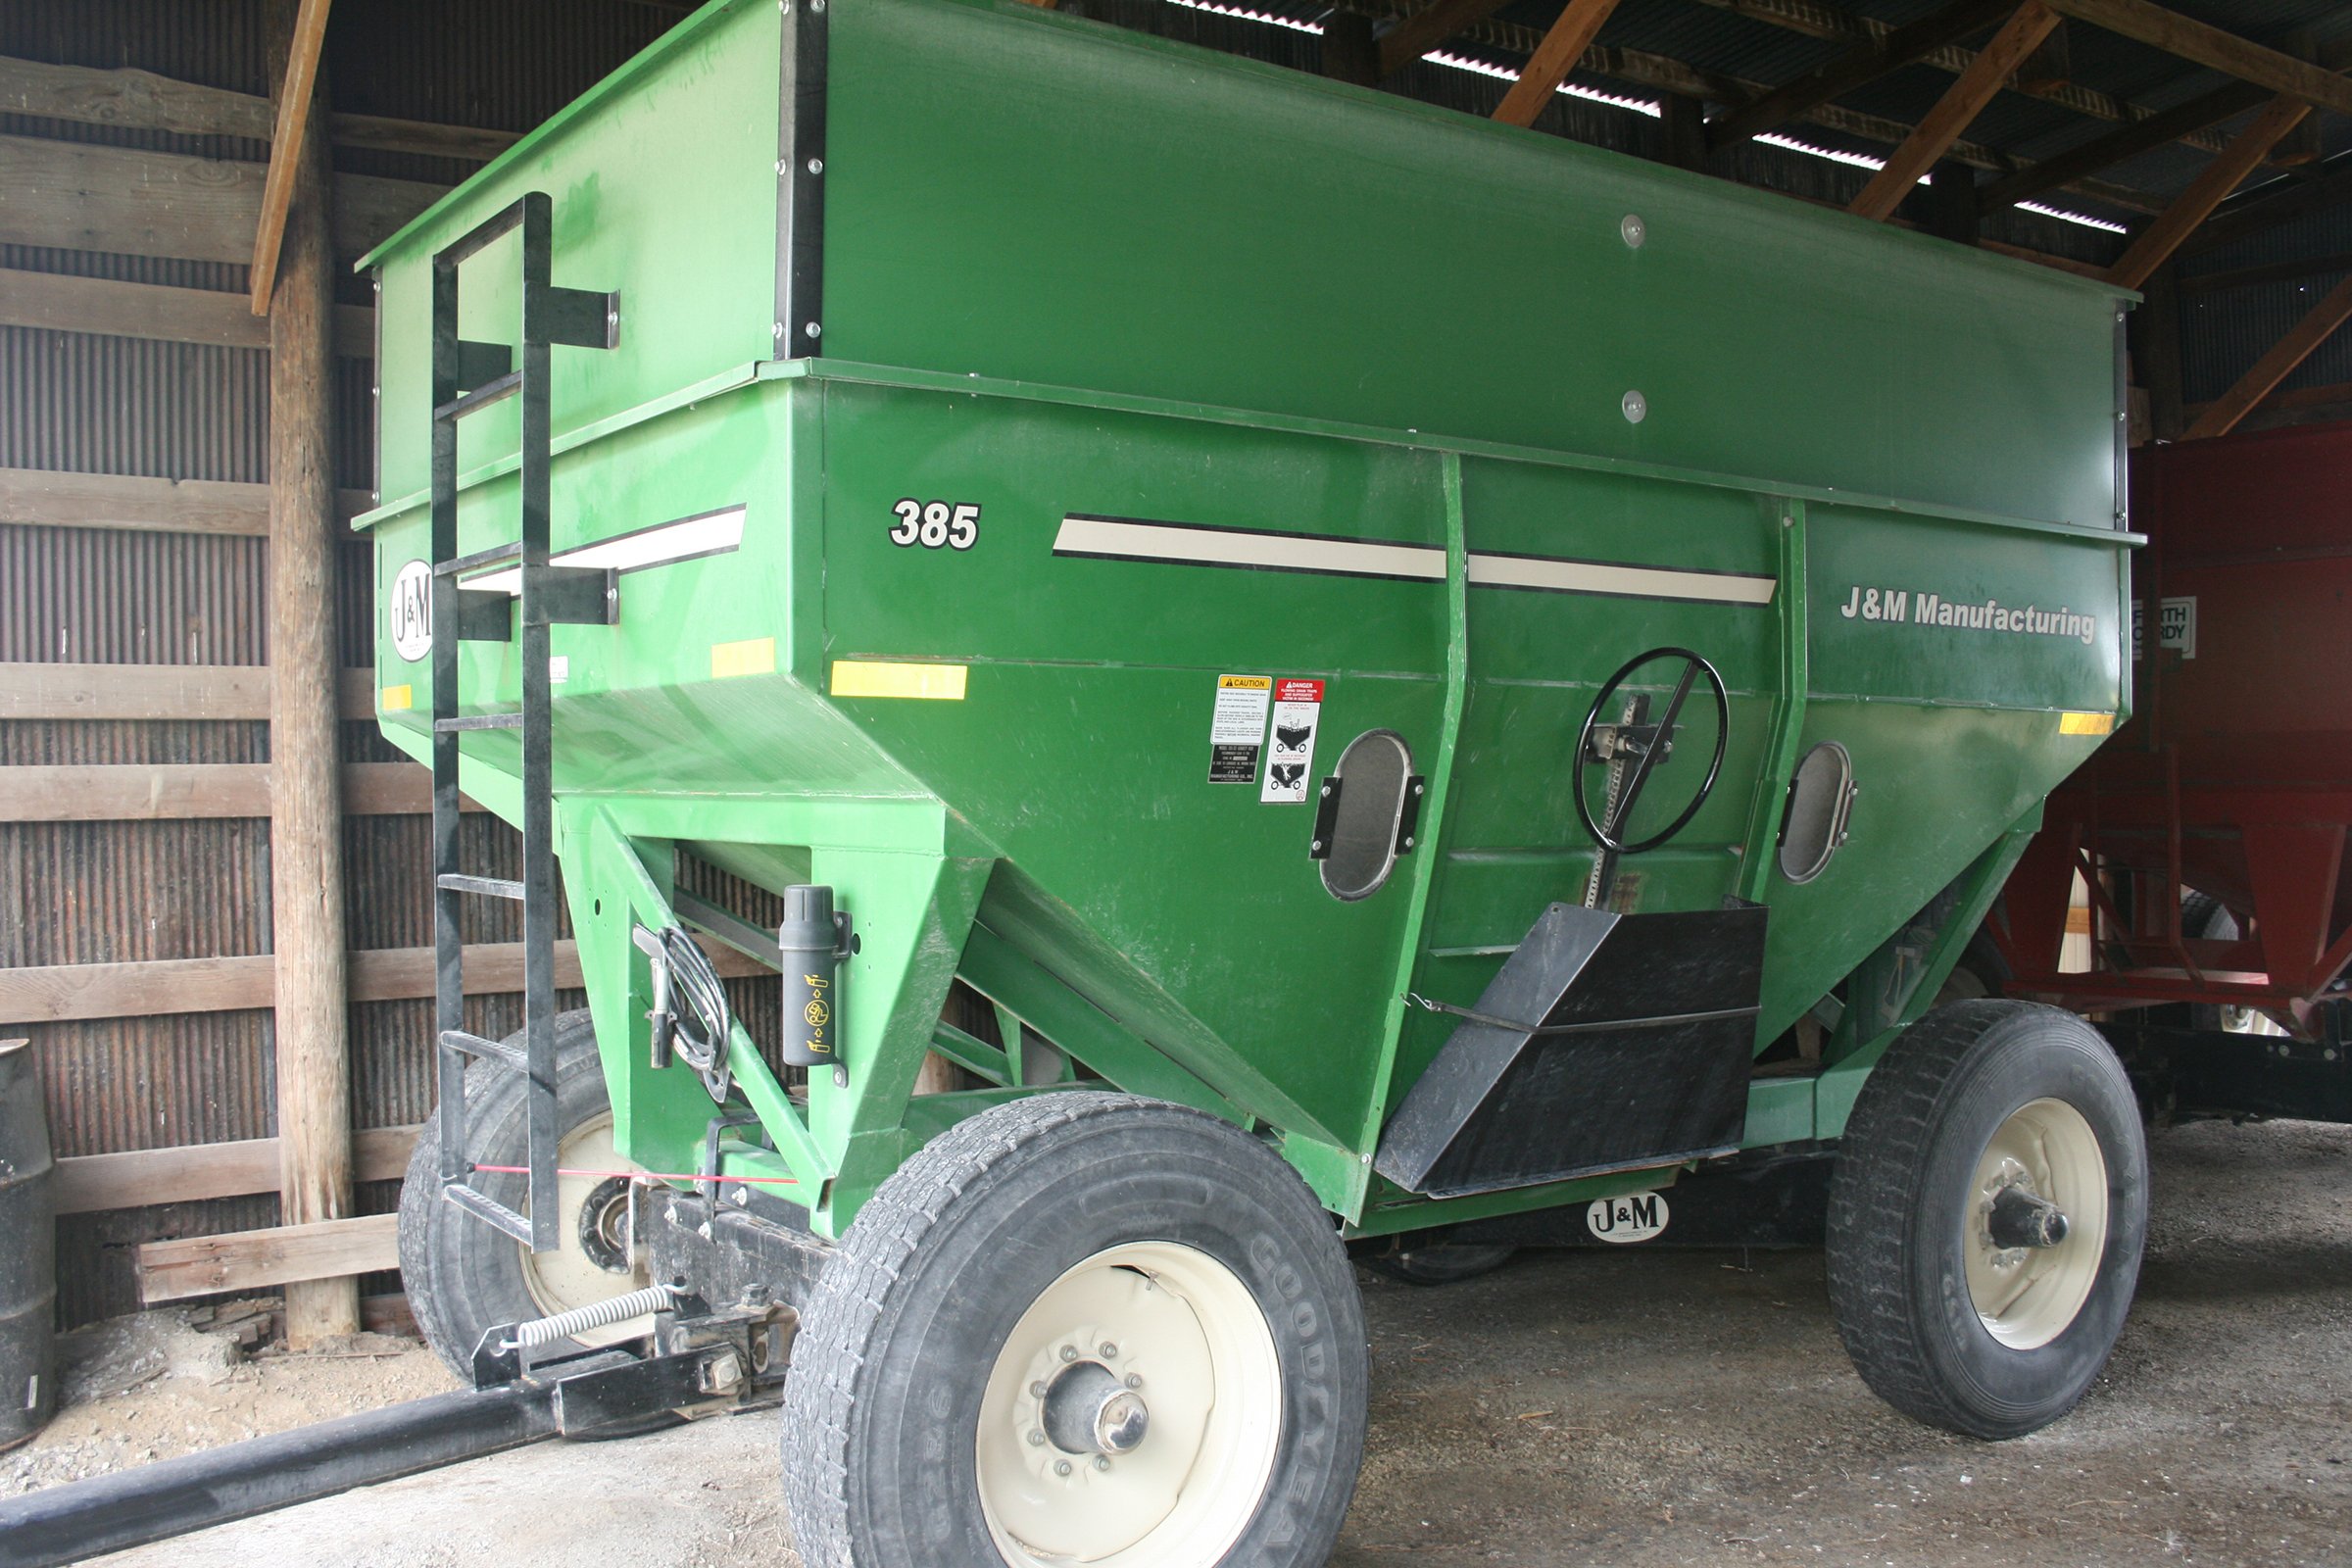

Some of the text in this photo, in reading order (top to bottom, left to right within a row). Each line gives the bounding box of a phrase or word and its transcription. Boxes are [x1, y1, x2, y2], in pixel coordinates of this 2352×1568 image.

[890, 499, 980, 550] 385
[395, 573, 431, 642] J&M
[1840, 586, 2096, 645] J&M Manufacturing
[1234, 678, 1265, 688] CAUTION
[1592, 1195, 1660, 1233] J&M
[1250, 1232, 1331, 1568] GOODYEA
